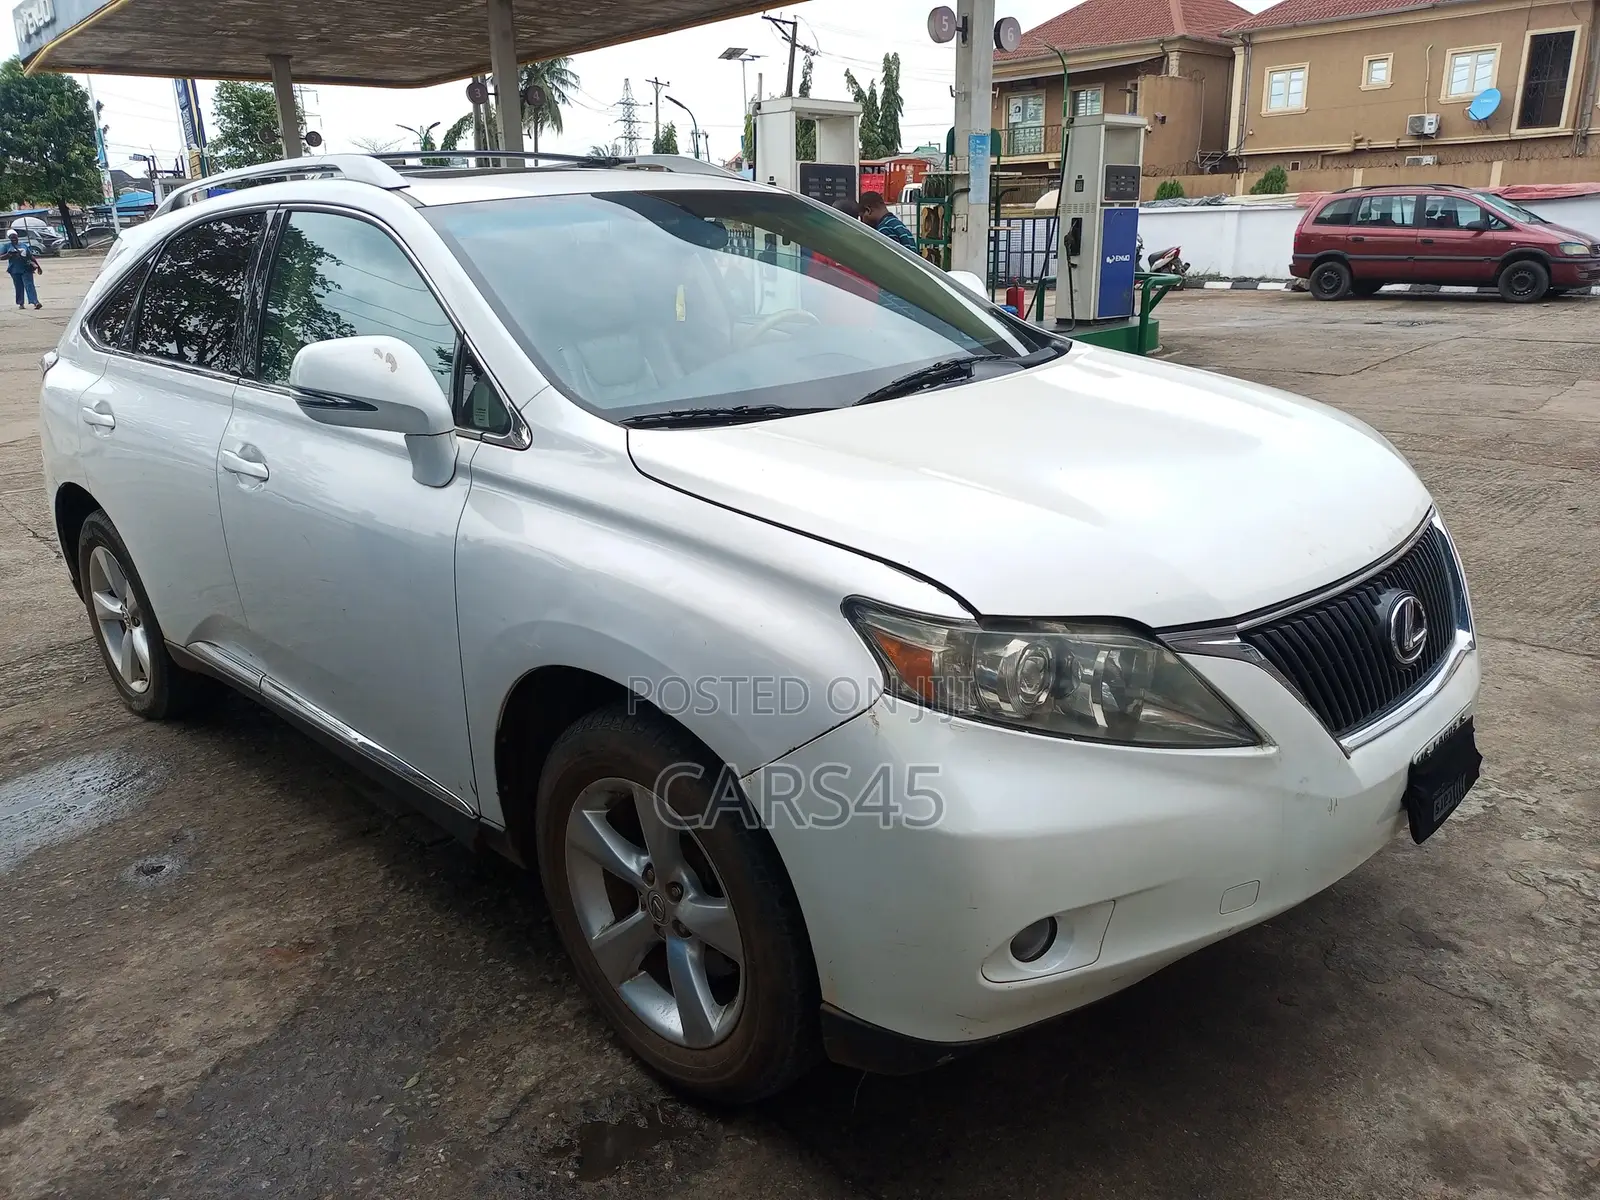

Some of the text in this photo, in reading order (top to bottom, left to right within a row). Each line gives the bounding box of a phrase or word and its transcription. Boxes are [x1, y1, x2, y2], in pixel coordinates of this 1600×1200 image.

[942, 15, 949, 32] 5
[1007, 27, 1014, 42] 6
[474, 88, 482, 98] 3
[533, 91, 540, 100] 4
